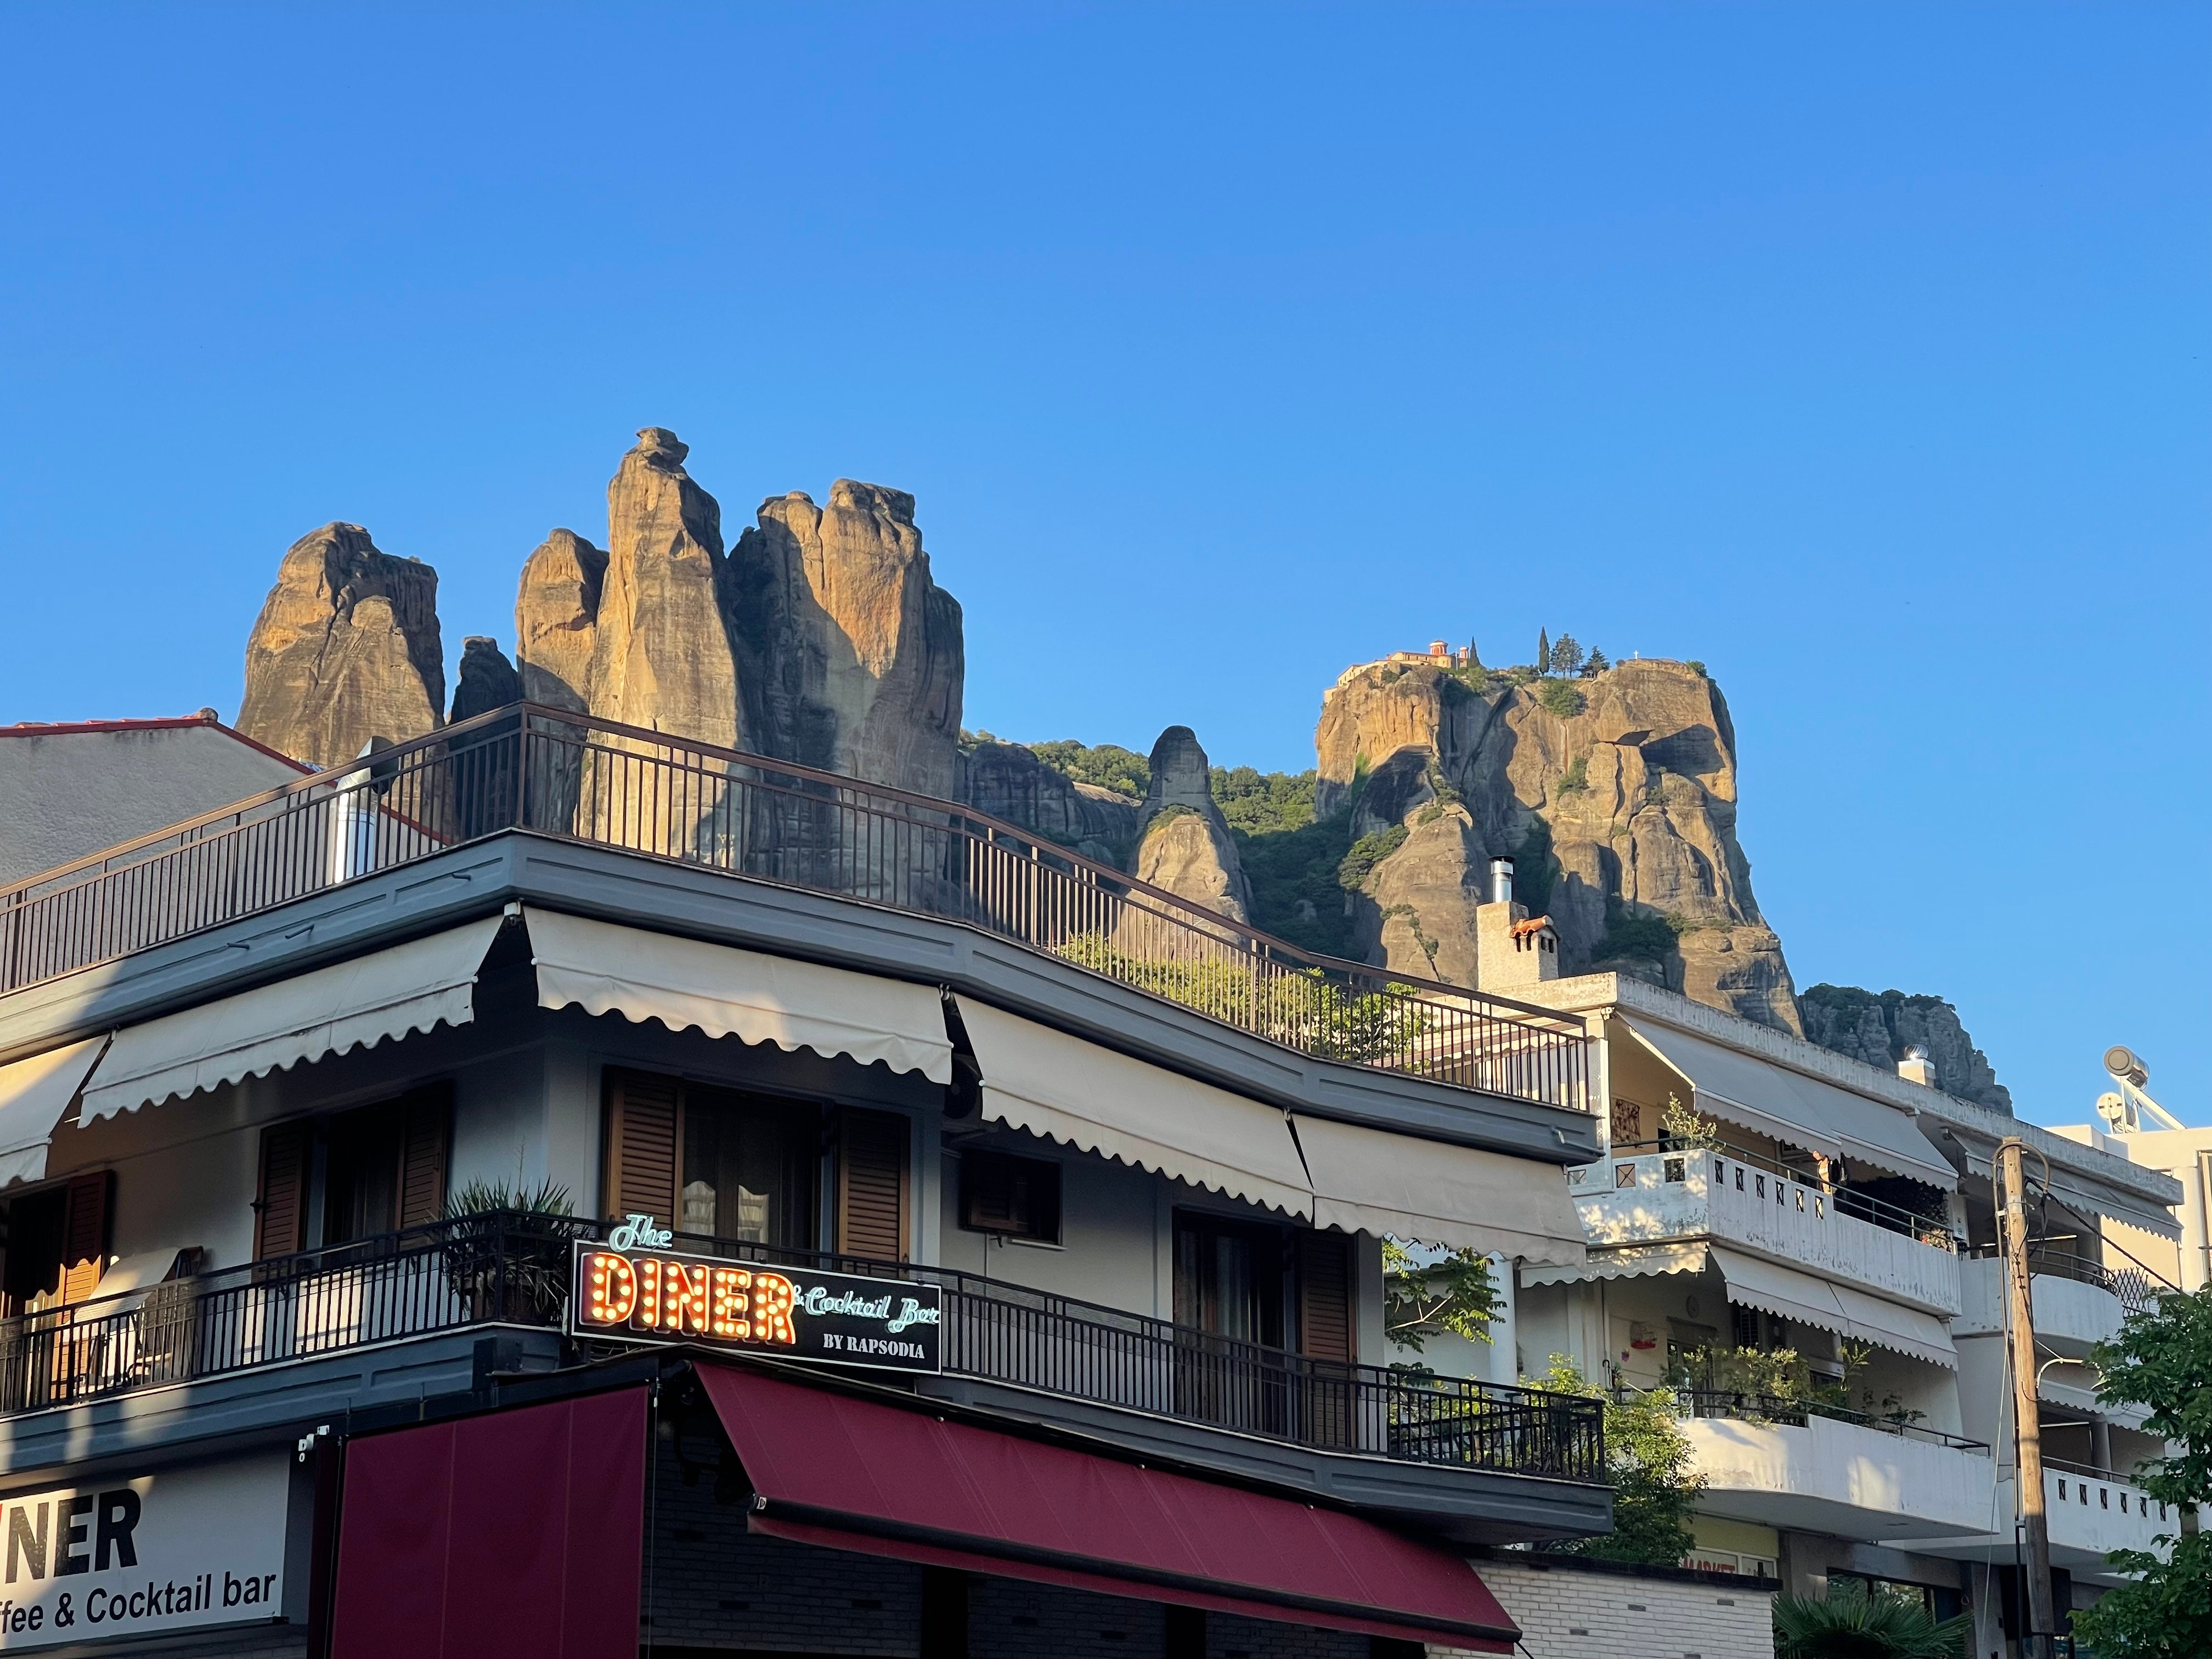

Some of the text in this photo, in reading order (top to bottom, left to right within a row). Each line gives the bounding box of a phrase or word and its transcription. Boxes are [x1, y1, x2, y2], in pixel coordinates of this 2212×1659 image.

[610, 1214, 673, 1252] The
[585, 1252, 795, 1347] DINER
[804, 1286, 891, 1318] Cocktail
[885, 1297, 939, 1333] Bar
[823, 1334, 924, 1359] BY RAPSODIA
[0, 1488, 141, 1584] NER
[0, 1571, 276, 1634] fee & Cocktail bar
